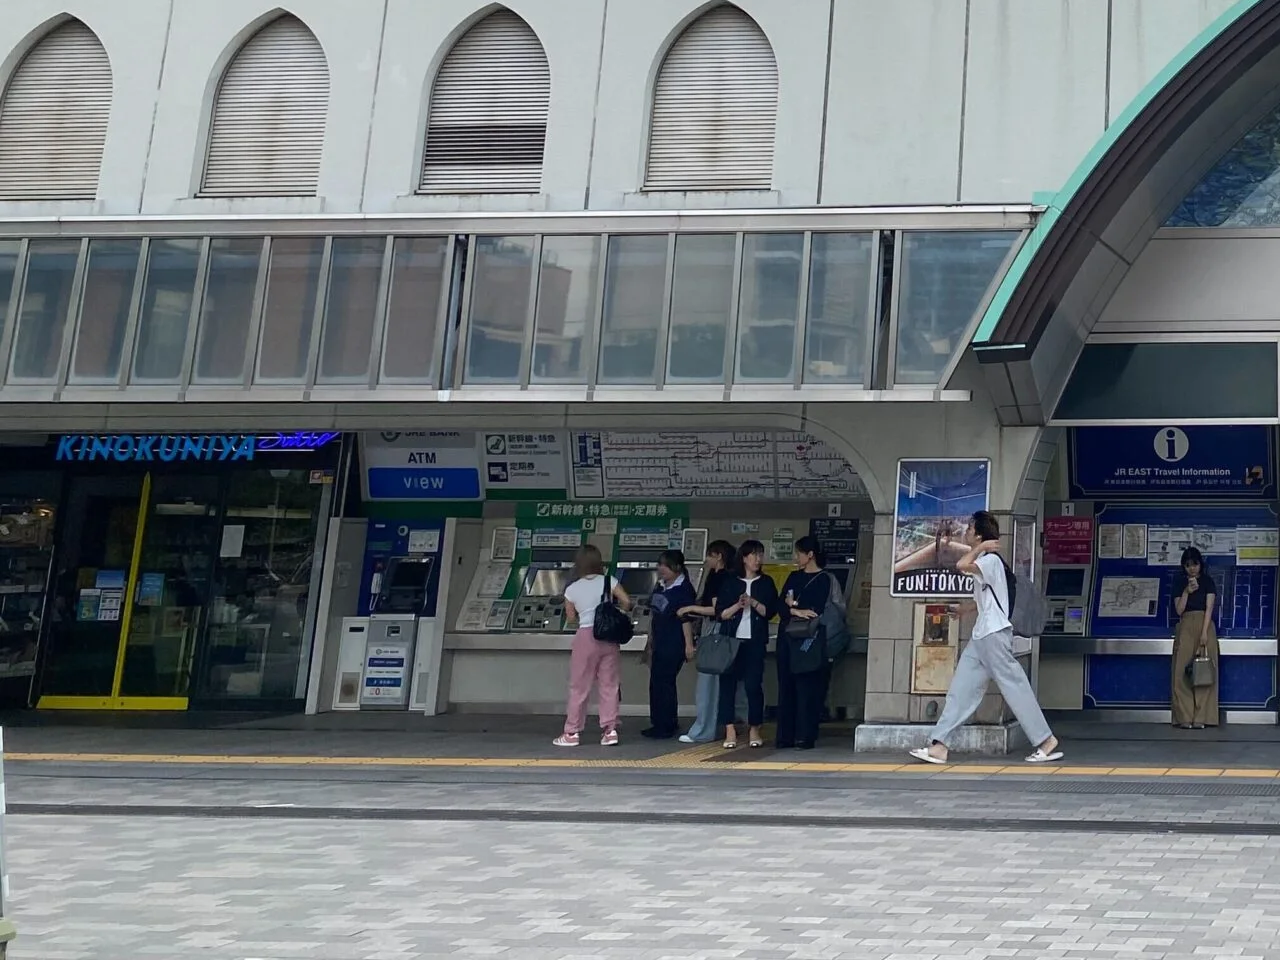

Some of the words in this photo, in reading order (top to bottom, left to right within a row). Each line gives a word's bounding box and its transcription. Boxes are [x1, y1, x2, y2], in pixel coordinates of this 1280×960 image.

[56, 434, 256, 461] KINOKUNIYA
[408, 452, 437, 464] ATM
[1114, 468, 1126, 476] JR
[1128, 468, 1152, 476] EAST
[1154, 468, 1180, 476] Travel
[1182, 468, 1231, 476] Information
[831, 506, 838, 515] 4
[1065, 505, 1070, 514] 1
[585, 519, 592, 529] 6
[672, 519, 679, 529] 5
